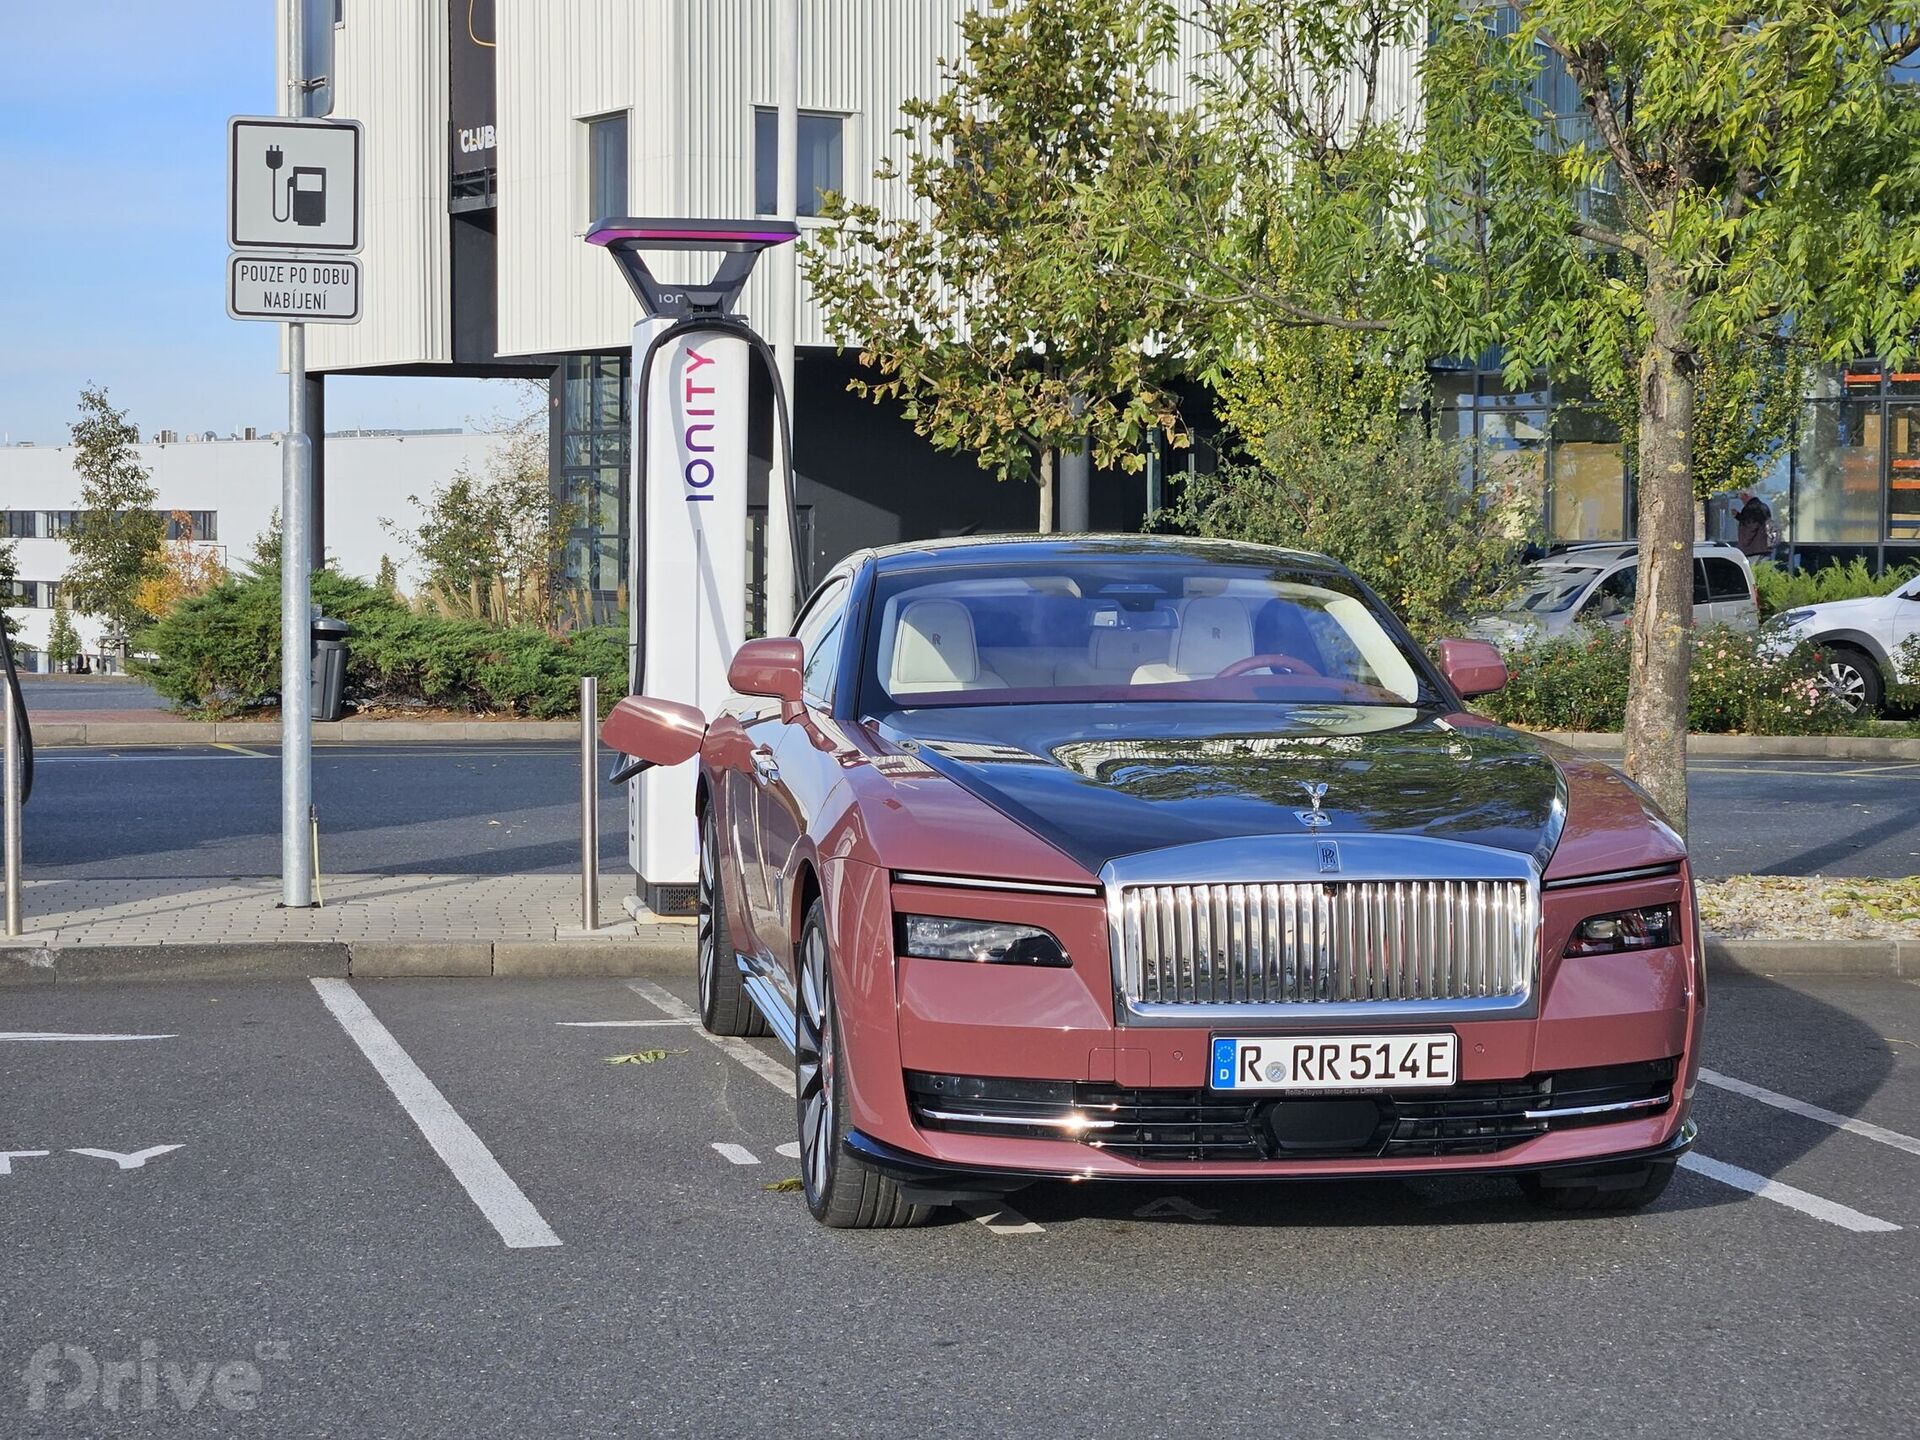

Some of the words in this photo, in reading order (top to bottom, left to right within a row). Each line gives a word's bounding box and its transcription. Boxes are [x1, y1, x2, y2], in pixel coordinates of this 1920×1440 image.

[241, 265, 284, 283] POUZE
[290, 267, 307, 283] PO
[313, 268, 350, 285] DOBU
[264, 289, 328, 310] NABÍJENÍ
[685, 347, 715, 502] IONITY
[1220, 1068, 1229, 1080] D
[1240, 1046, 1263, 1082] R
